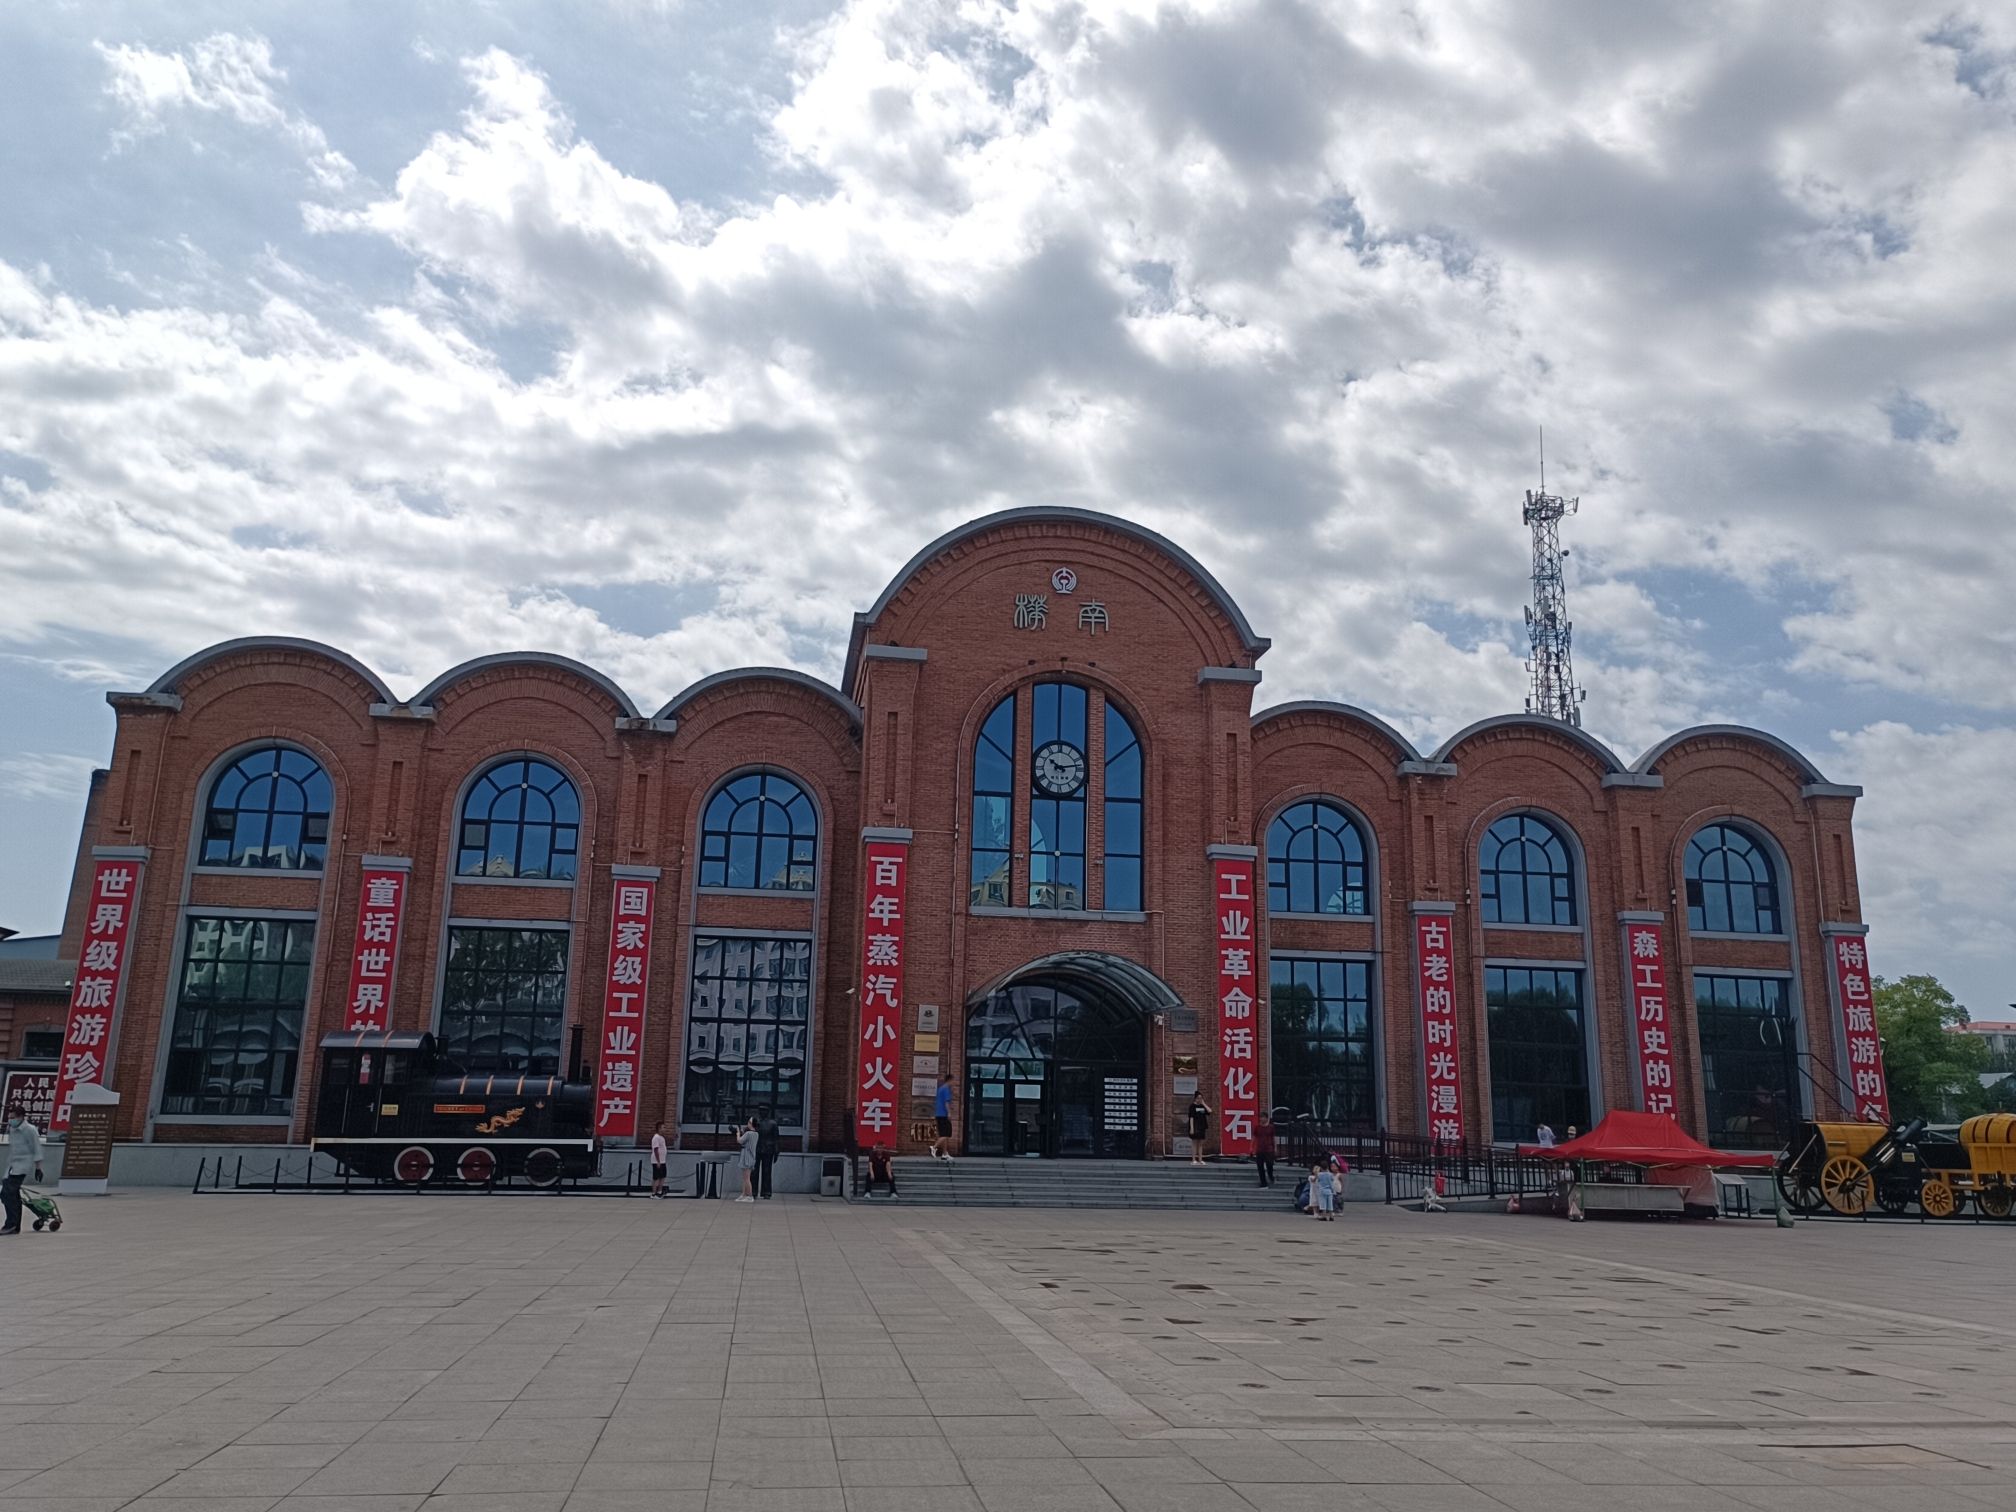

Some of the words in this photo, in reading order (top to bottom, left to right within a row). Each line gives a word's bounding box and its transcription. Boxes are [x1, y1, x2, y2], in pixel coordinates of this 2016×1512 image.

[599, 886, 648, 1127] 国家级工业遗产
[860, 856, 903, 1132] 百年蒸汽小火车
[1219, 874, 1255, 1140] 工业革命活化石
[1421, 921, 1460, 1145] 古老的时光漫游
[1633, 931, 1675, 1119] 森工历史的记
